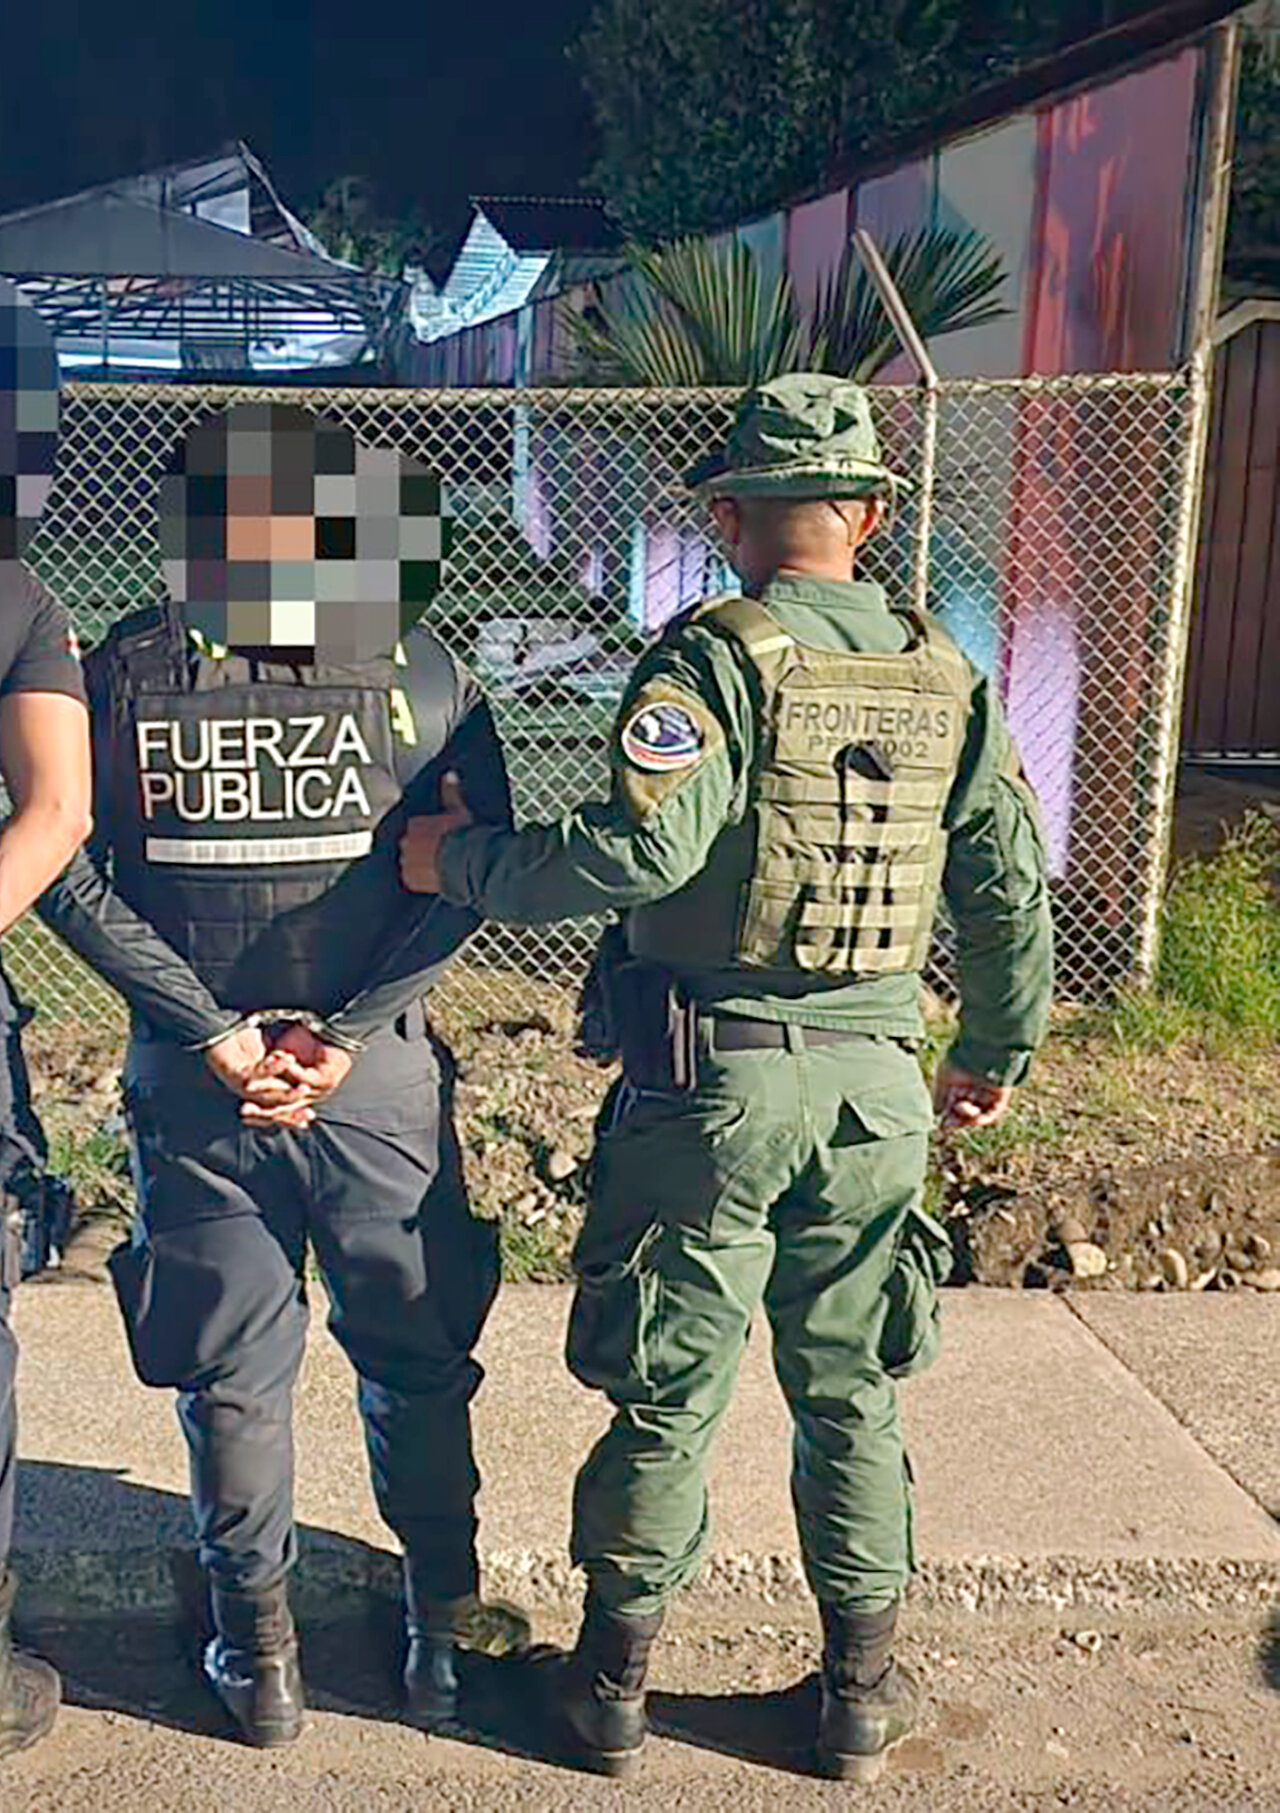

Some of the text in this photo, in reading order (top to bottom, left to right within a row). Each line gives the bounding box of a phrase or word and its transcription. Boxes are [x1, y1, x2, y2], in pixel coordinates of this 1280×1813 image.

[136, 714, 372, 770] FUERZA
[786, 701, 950, 739] FRONTERAS
[140, 766, 372, 821] PUBLICA
